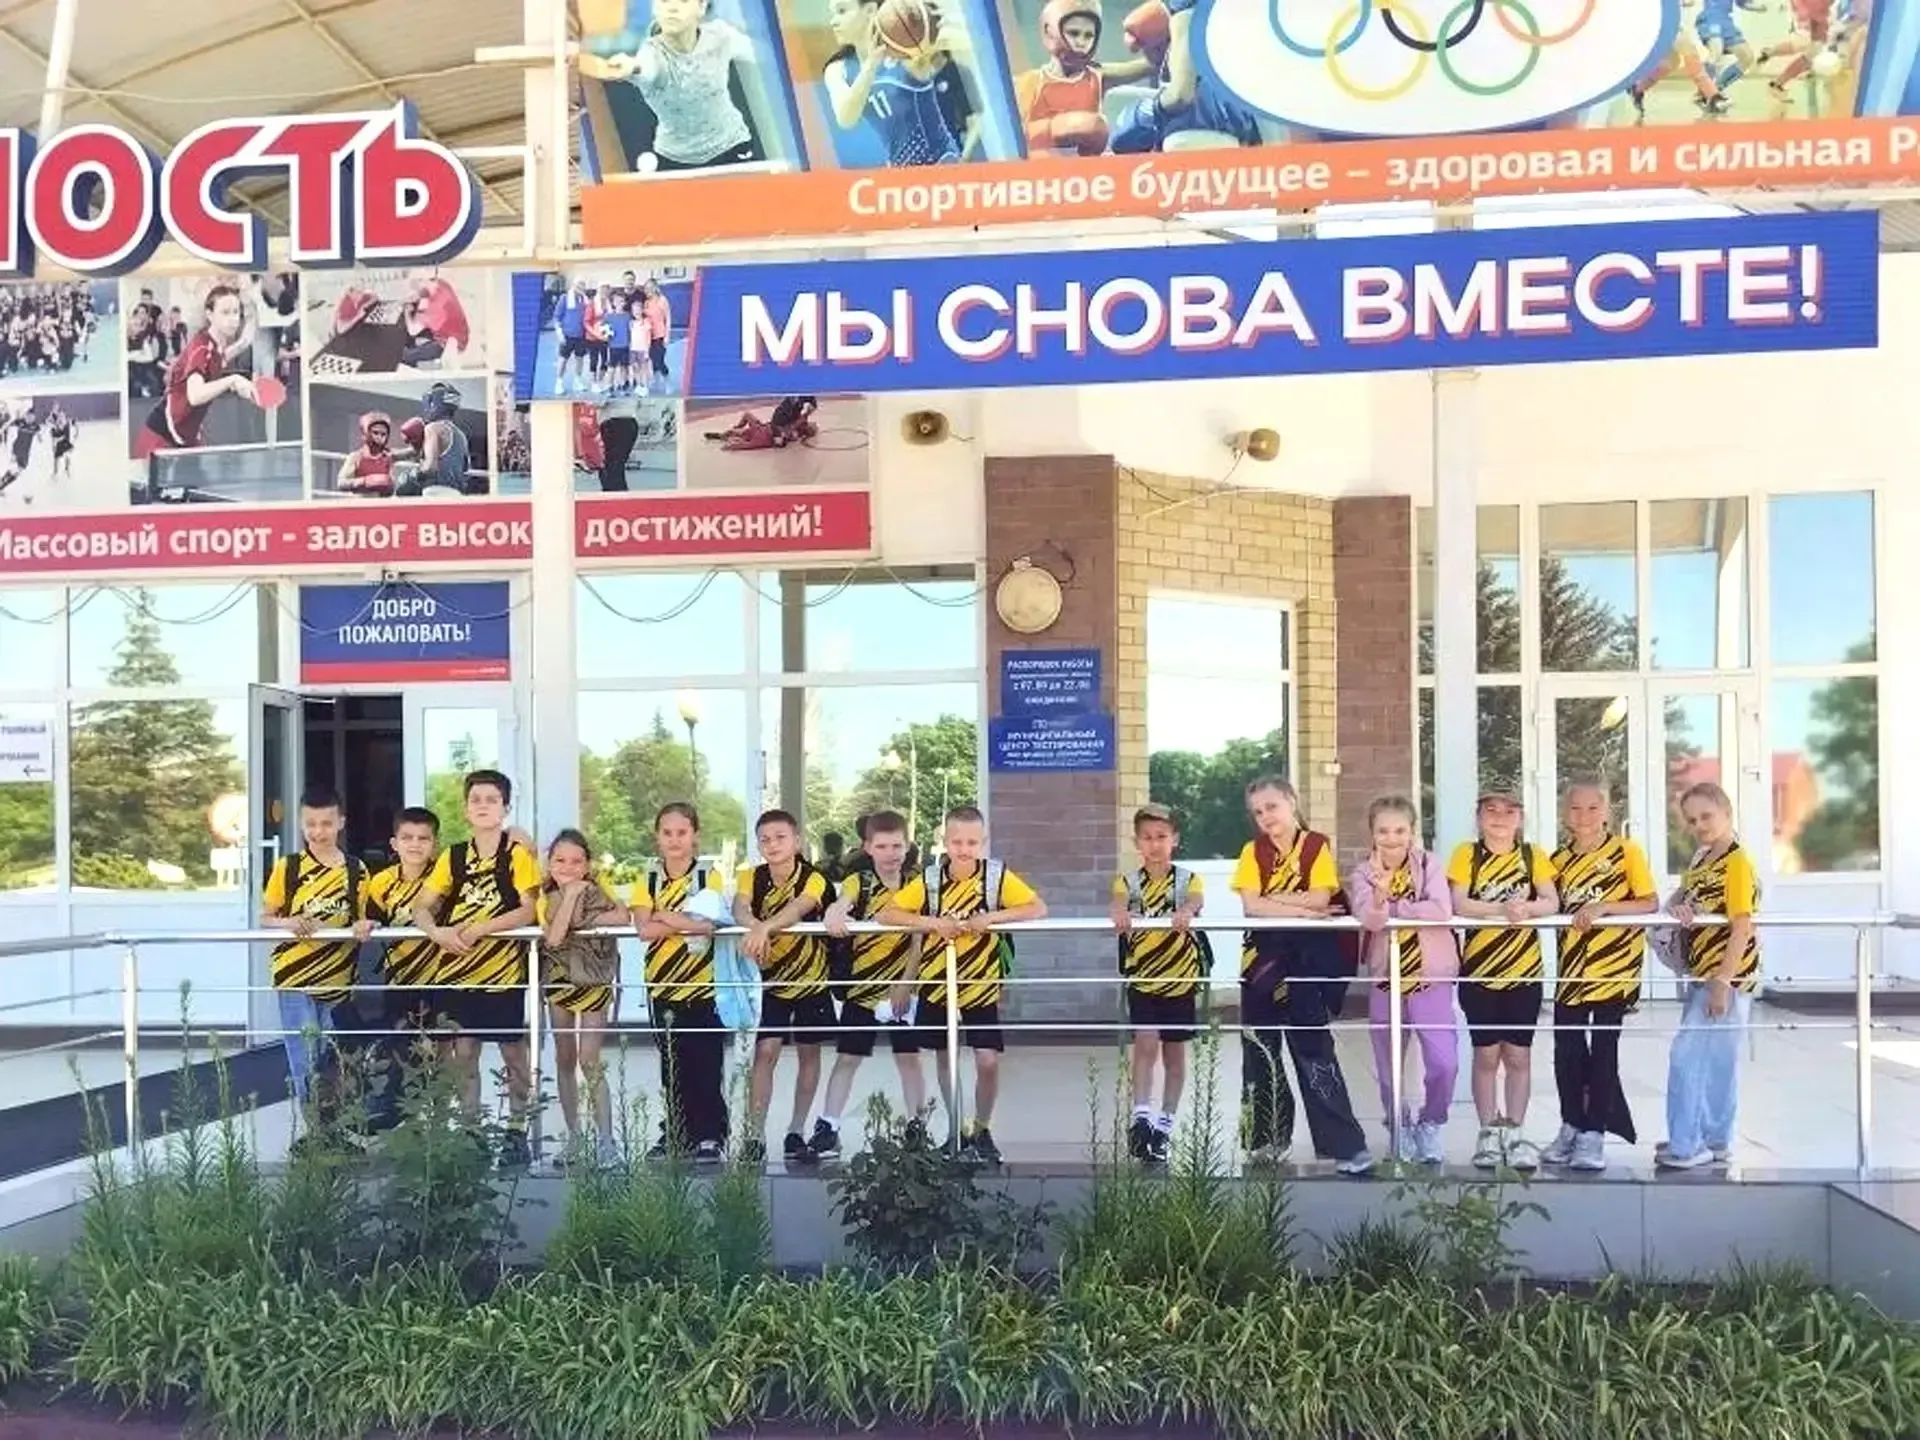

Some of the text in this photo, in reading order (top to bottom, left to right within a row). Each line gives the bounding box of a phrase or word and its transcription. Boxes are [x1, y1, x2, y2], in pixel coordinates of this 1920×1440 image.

[848, 172, 1115, 219] Спортивное
[1130, 160, 1331, 208] будущее
[1386, 145, 1613, 190] здоровая
[1630, 145, 1657, 173] и
[1675, 136, 1871, 171] сильная
[1889, 126, 1920, 165] Р
[740, 244, 1822, 367] МЫ СНОВА ВМЕСТЕ!
[169, 526, 272, 558] спорт
[307, 522, 408, 551] залог
[418, 520, 532, 548] высок
[583, 504, 823, 548] достижений!
[338, 622, 472, 645] ПОЖАЛОВАТЬ!
[372, 598, 437, 620] ДОБРО
